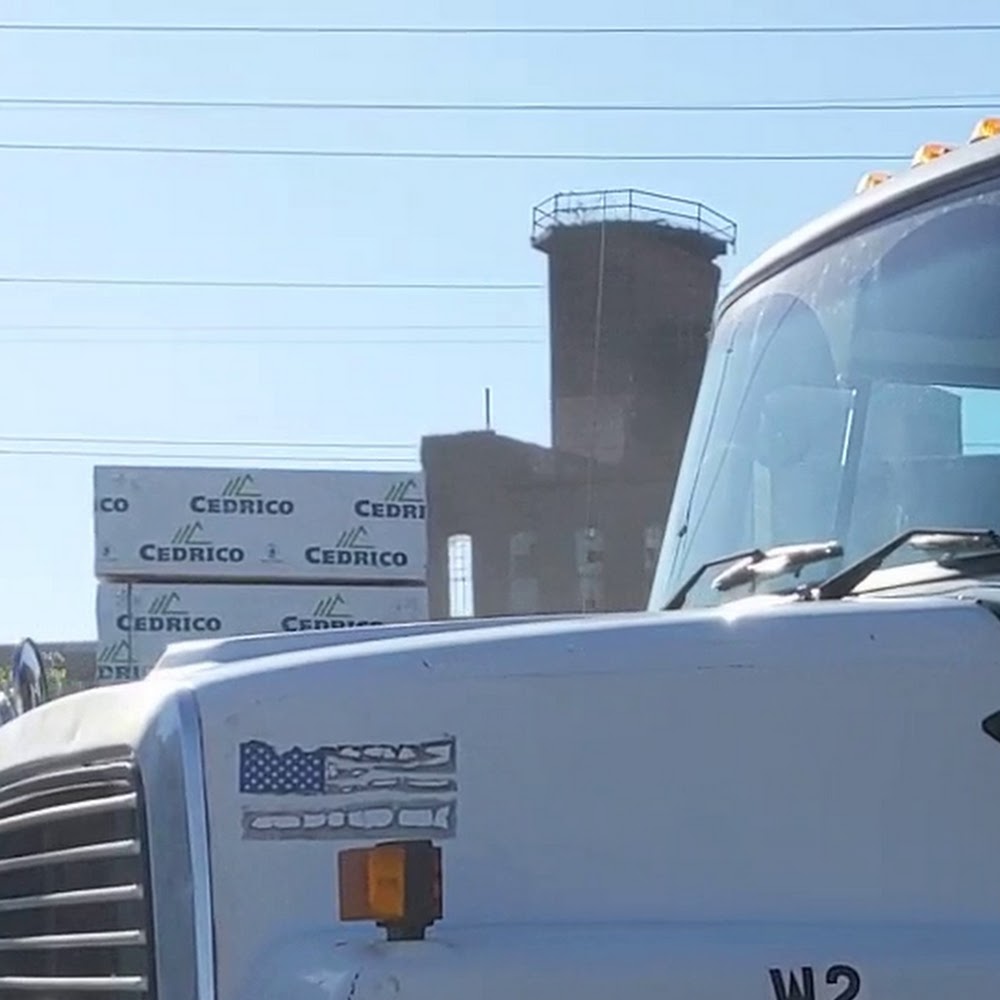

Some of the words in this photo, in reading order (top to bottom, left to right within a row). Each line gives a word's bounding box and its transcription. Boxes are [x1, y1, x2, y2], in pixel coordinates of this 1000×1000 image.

[190, 495, 294, 515] CEDRICO
[355, 500, 426, 519] CEDRI
[139, 544, 245, 563] CEDRICO
[305, 547, 408, 567] CEDRICO
[116, 614, 222, 632] CEDRICO
